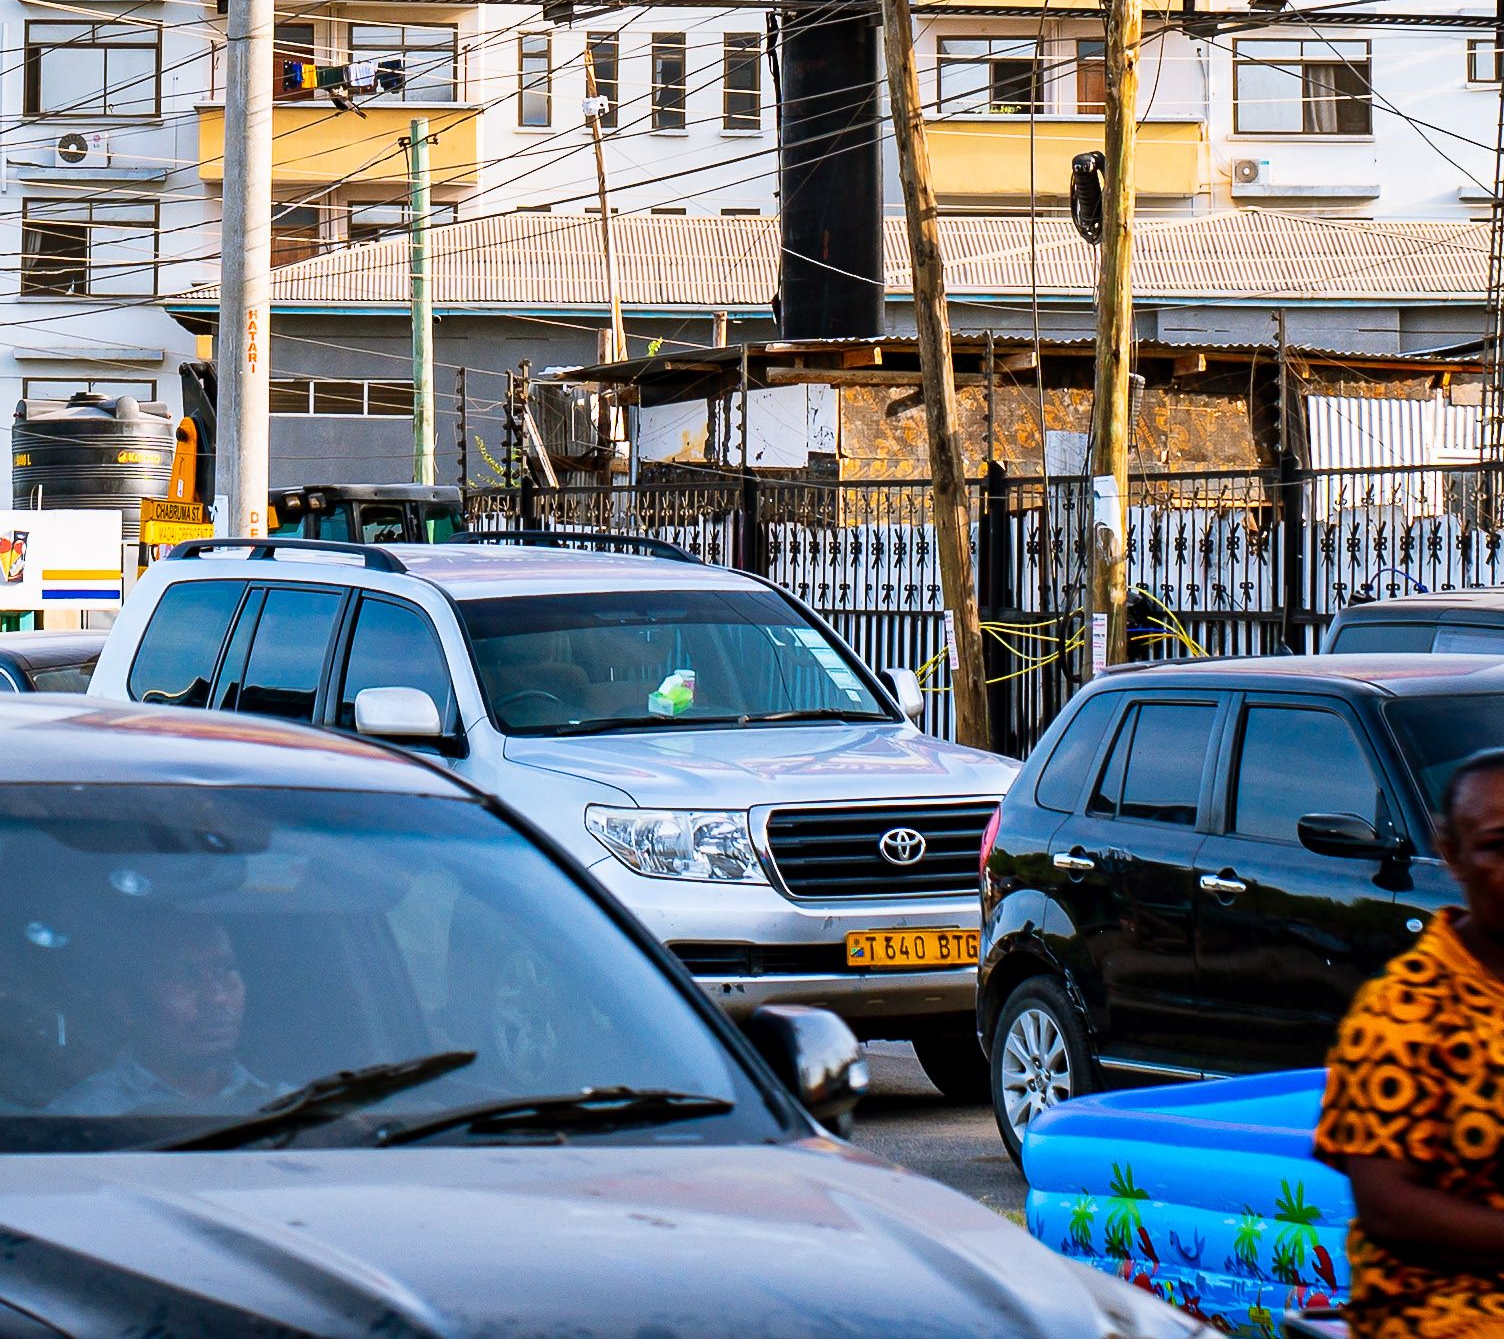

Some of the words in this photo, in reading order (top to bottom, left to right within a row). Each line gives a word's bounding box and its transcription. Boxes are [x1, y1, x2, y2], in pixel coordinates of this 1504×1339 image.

[248, 310, 258, 374] HATARI
[155, 504, 190, 520] CHABRUMA
[938, 934, 978, 959] BTG
